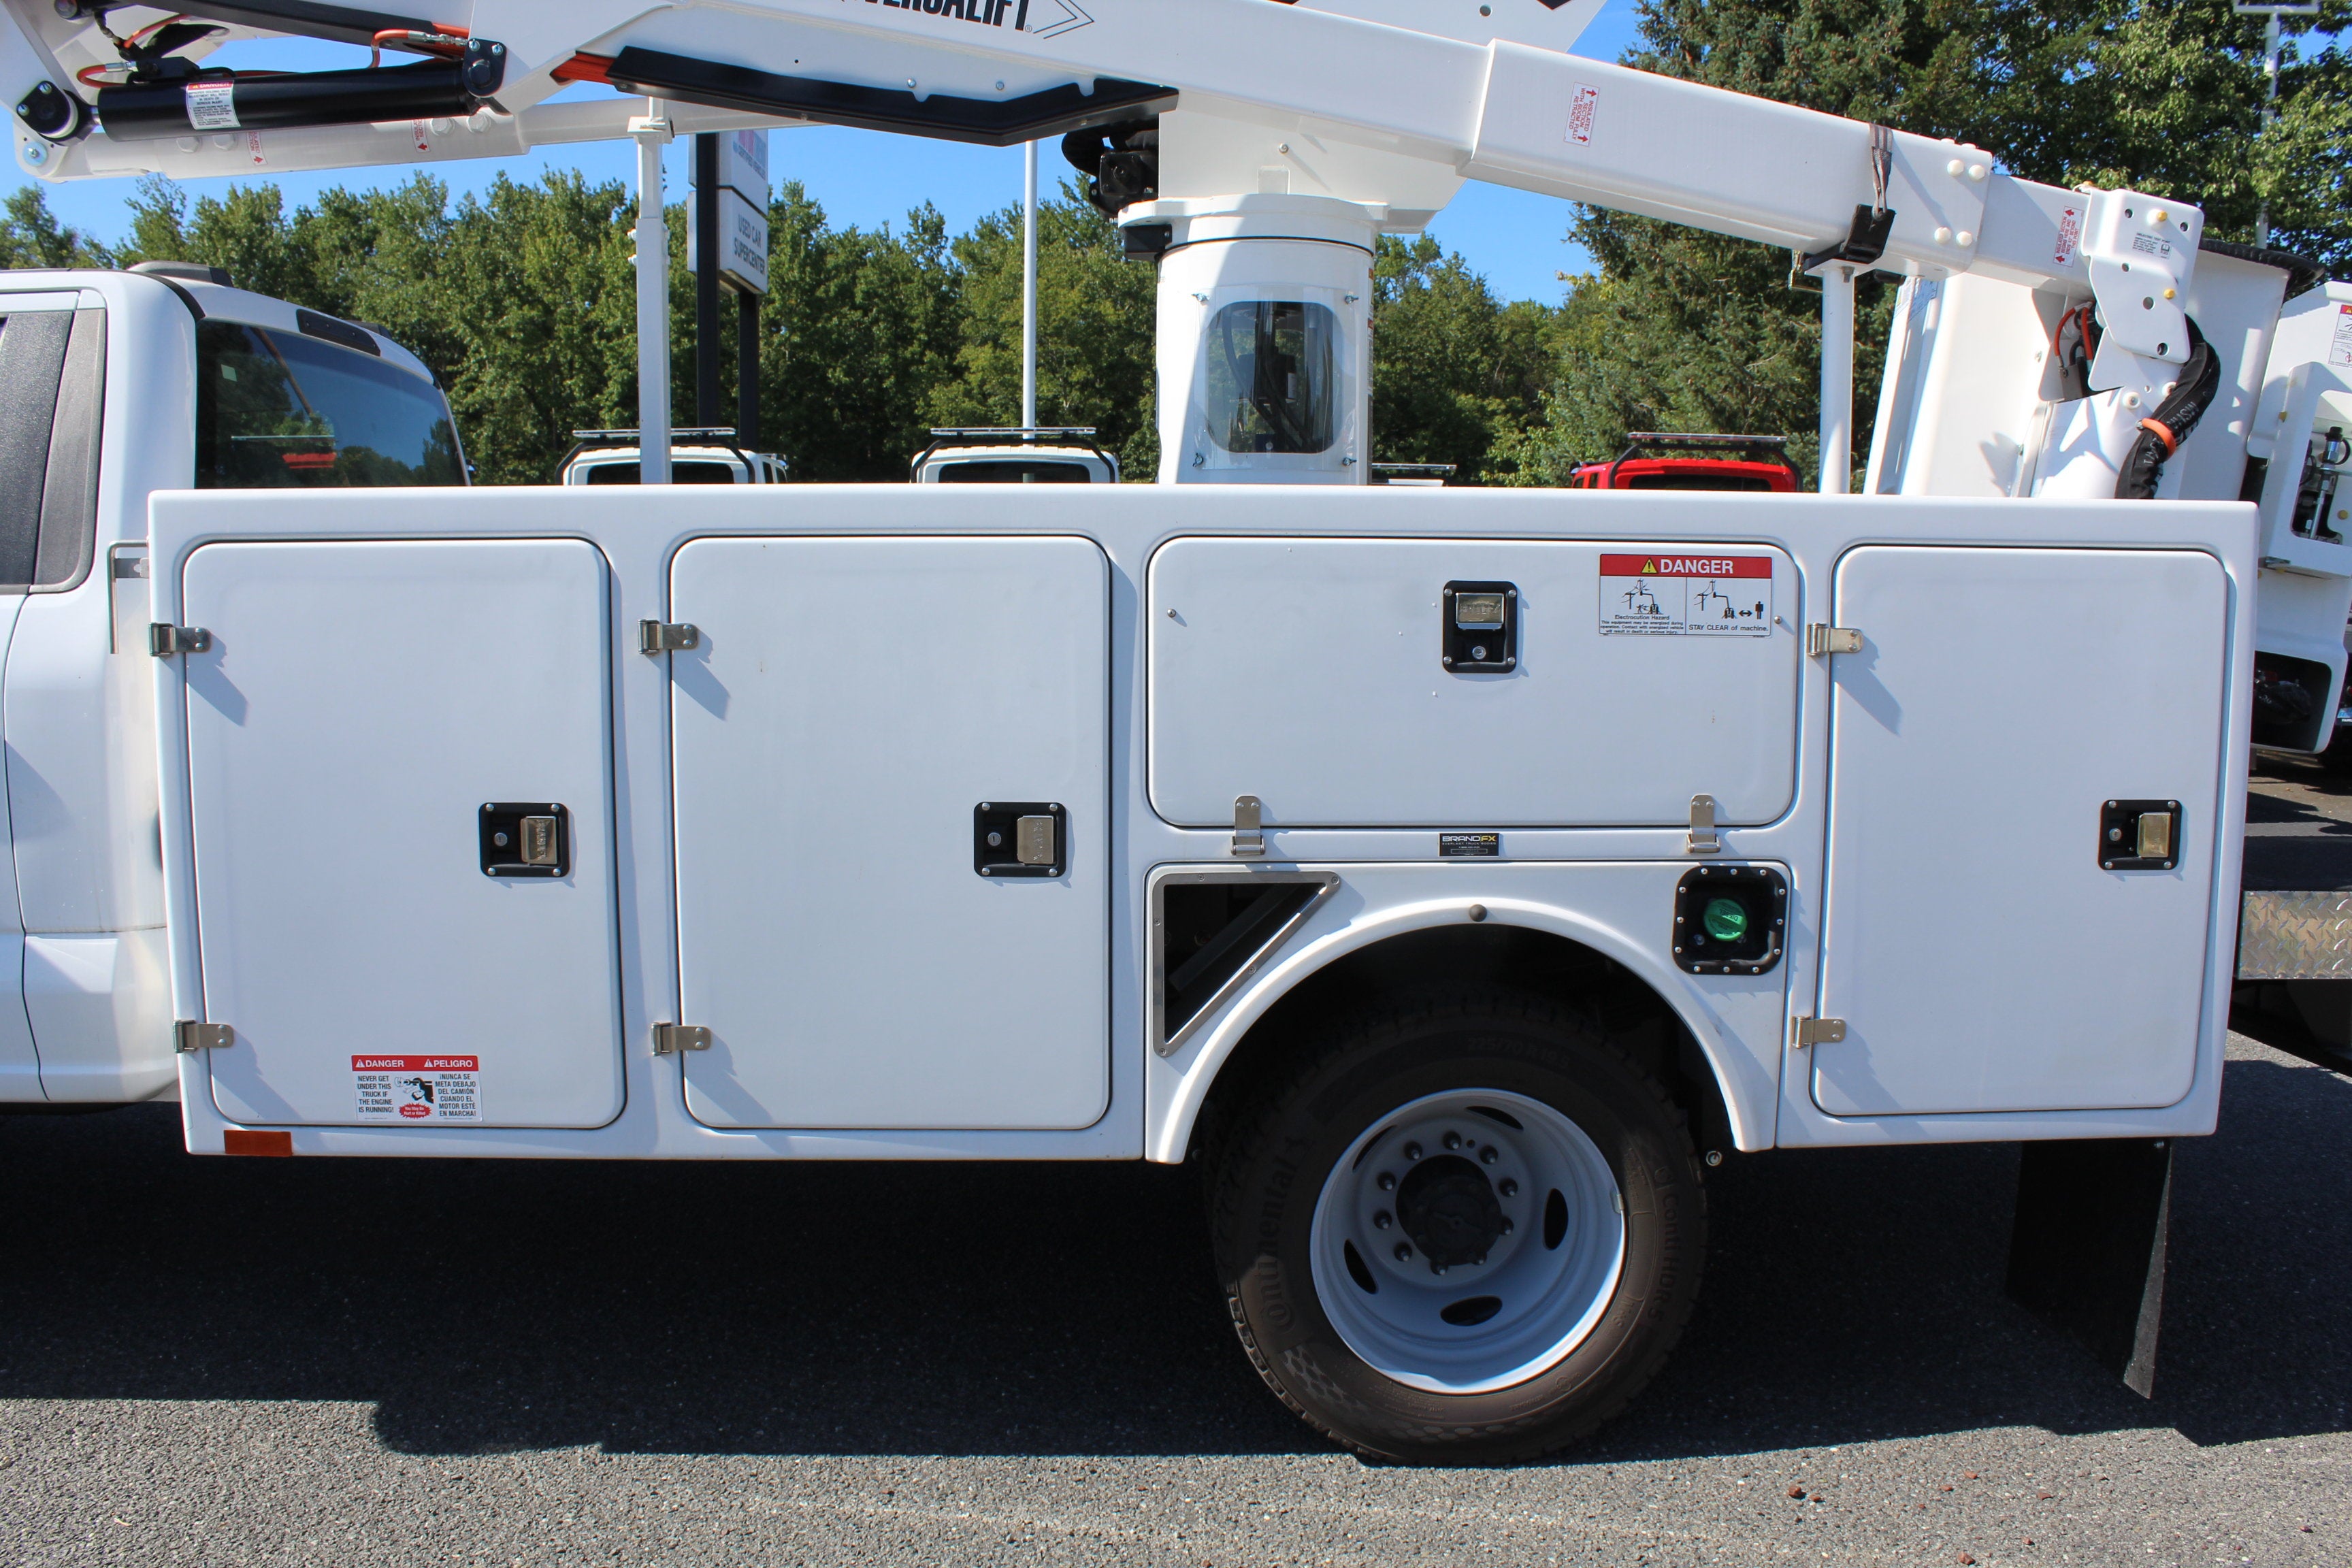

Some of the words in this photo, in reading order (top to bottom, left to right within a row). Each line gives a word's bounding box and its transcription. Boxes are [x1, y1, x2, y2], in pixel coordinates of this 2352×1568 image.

[1569, 95, 1579, 129] RETRACTED
[1580, 102, 1588, 127] SECTION
[1584, 100, 1594, 131] INSULATED
[738, 214, 751, 239] USED
[752, 225, 762, 249] CAR
[734, 237, 766, 276] SUPERCENTER
[1661, 559, 1733, 574] DANGER
[365, 1060, 404, 1068] DANGER
[434, 1060, 473, 1068] PELIGRO
[1257, 1156, 1298, 1334] Continental
